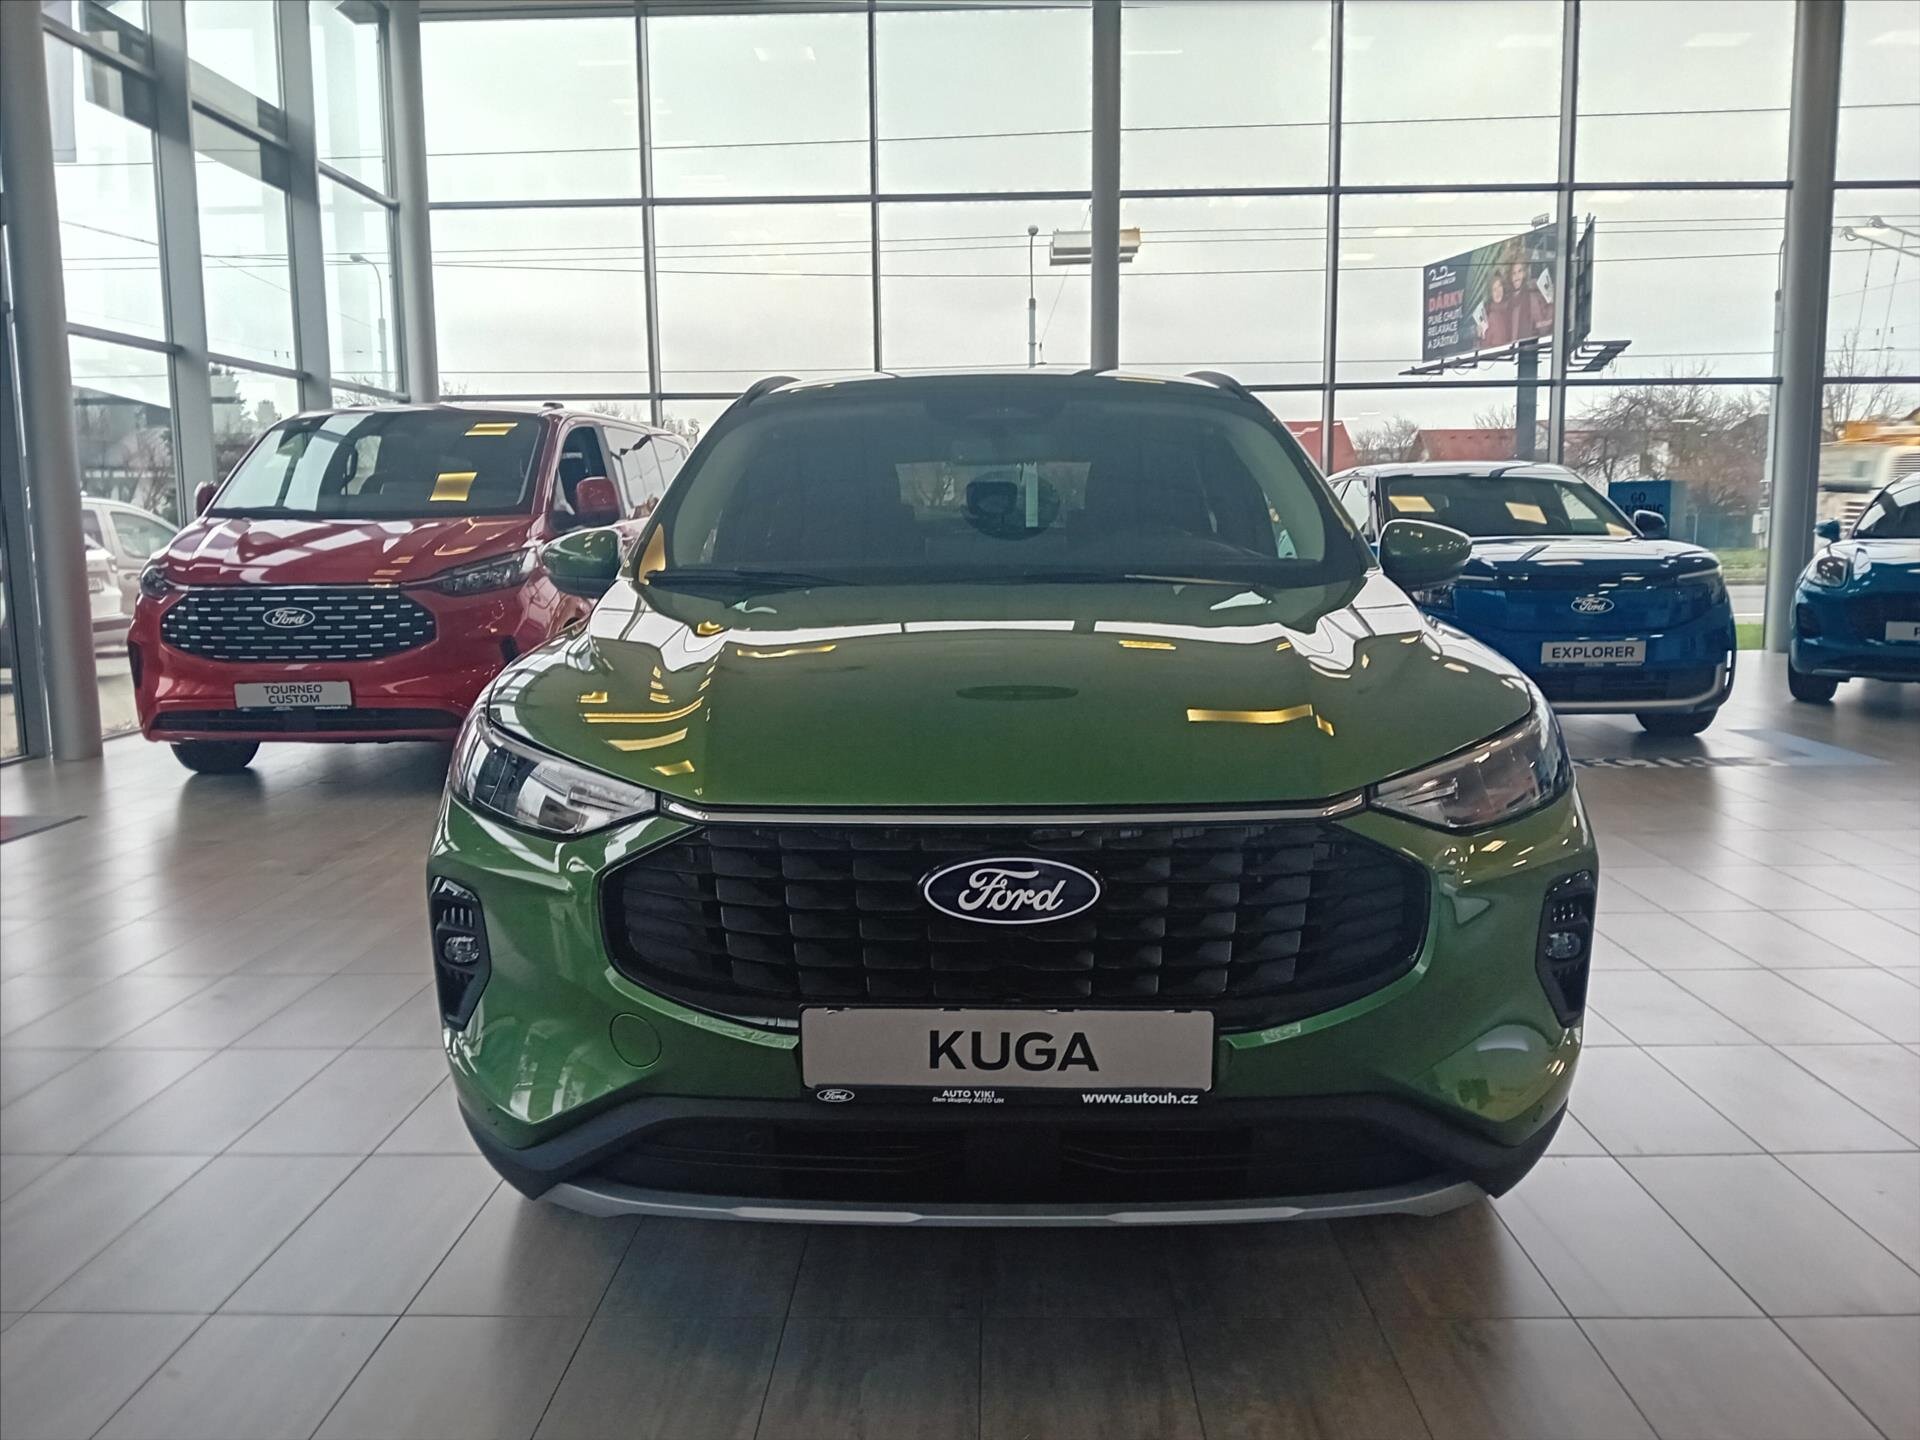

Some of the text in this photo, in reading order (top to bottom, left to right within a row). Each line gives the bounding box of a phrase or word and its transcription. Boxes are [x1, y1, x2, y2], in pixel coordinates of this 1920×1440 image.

[1551, 646, 1635, 659] EXPLORER
[263, 684, 323, 695] TOURNEO
[268, 694, 321, 705] CUSTOM
[957, 867, 1067, 912] Ford
[929, 1030, 1100, 1072] KUGA
[942, 1089, 995, 1098] AUTO VIKI
[1081, 1092, 1199, 1105] www.autouh.cz
